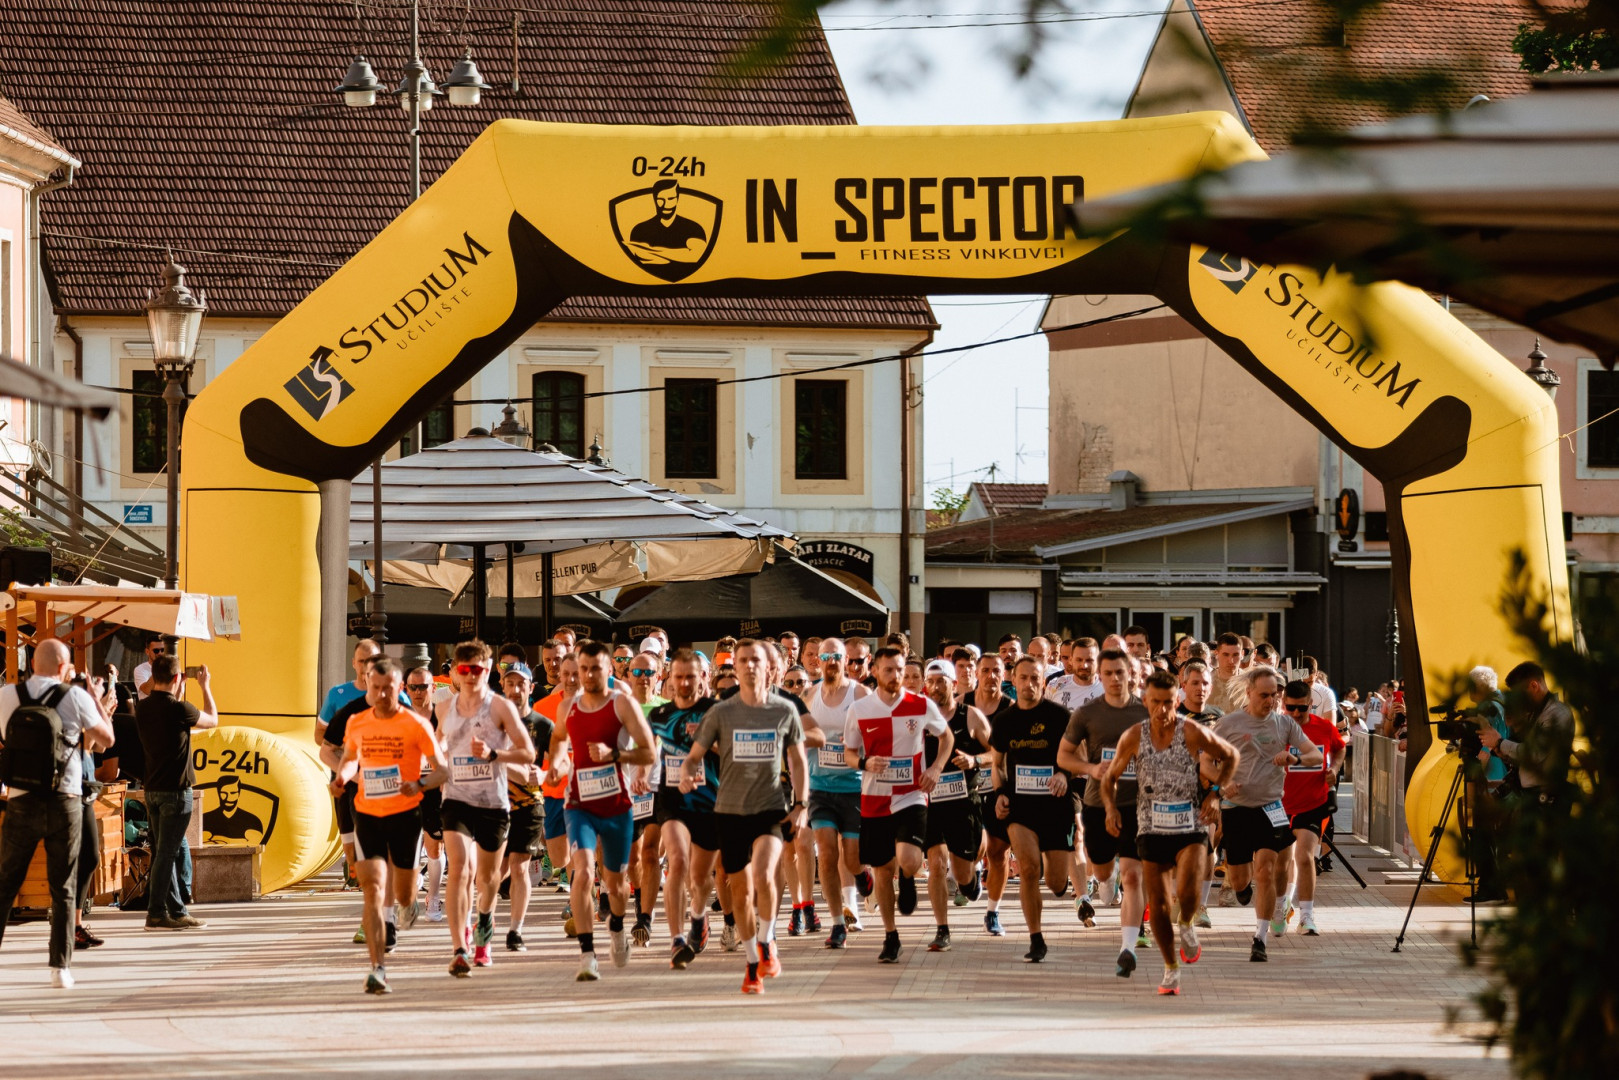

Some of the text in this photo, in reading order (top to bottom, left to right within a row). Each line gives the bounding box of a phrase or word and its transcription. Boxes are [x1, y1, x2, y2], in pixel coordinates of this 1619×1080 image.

[631, 156, 706, 177] 0-24h
[860, 246, 1065, 260] FITNESS VINKOVCI
[396, 286, 472, 350] UČILIŠTE
[1286, 329, 1362, 394] UČILIŠTE
[816, 544, 822, 552] I
[826, 543, 871, 563] ZLATAR
[535, 562, 597, 581] EELLENT PUB
[740, 619, 760, 631] ŽUJA
[756, 742, 774, 754] 020
[192, 748, 269, 774] 0-24h
[472, 765, 491, 777] 042
[896, 768, 910, 779] 143
[599, 776, 616, 790] 140
[949, 781, 963, 793] 018
[1174, 812, 1190, 825] 134
